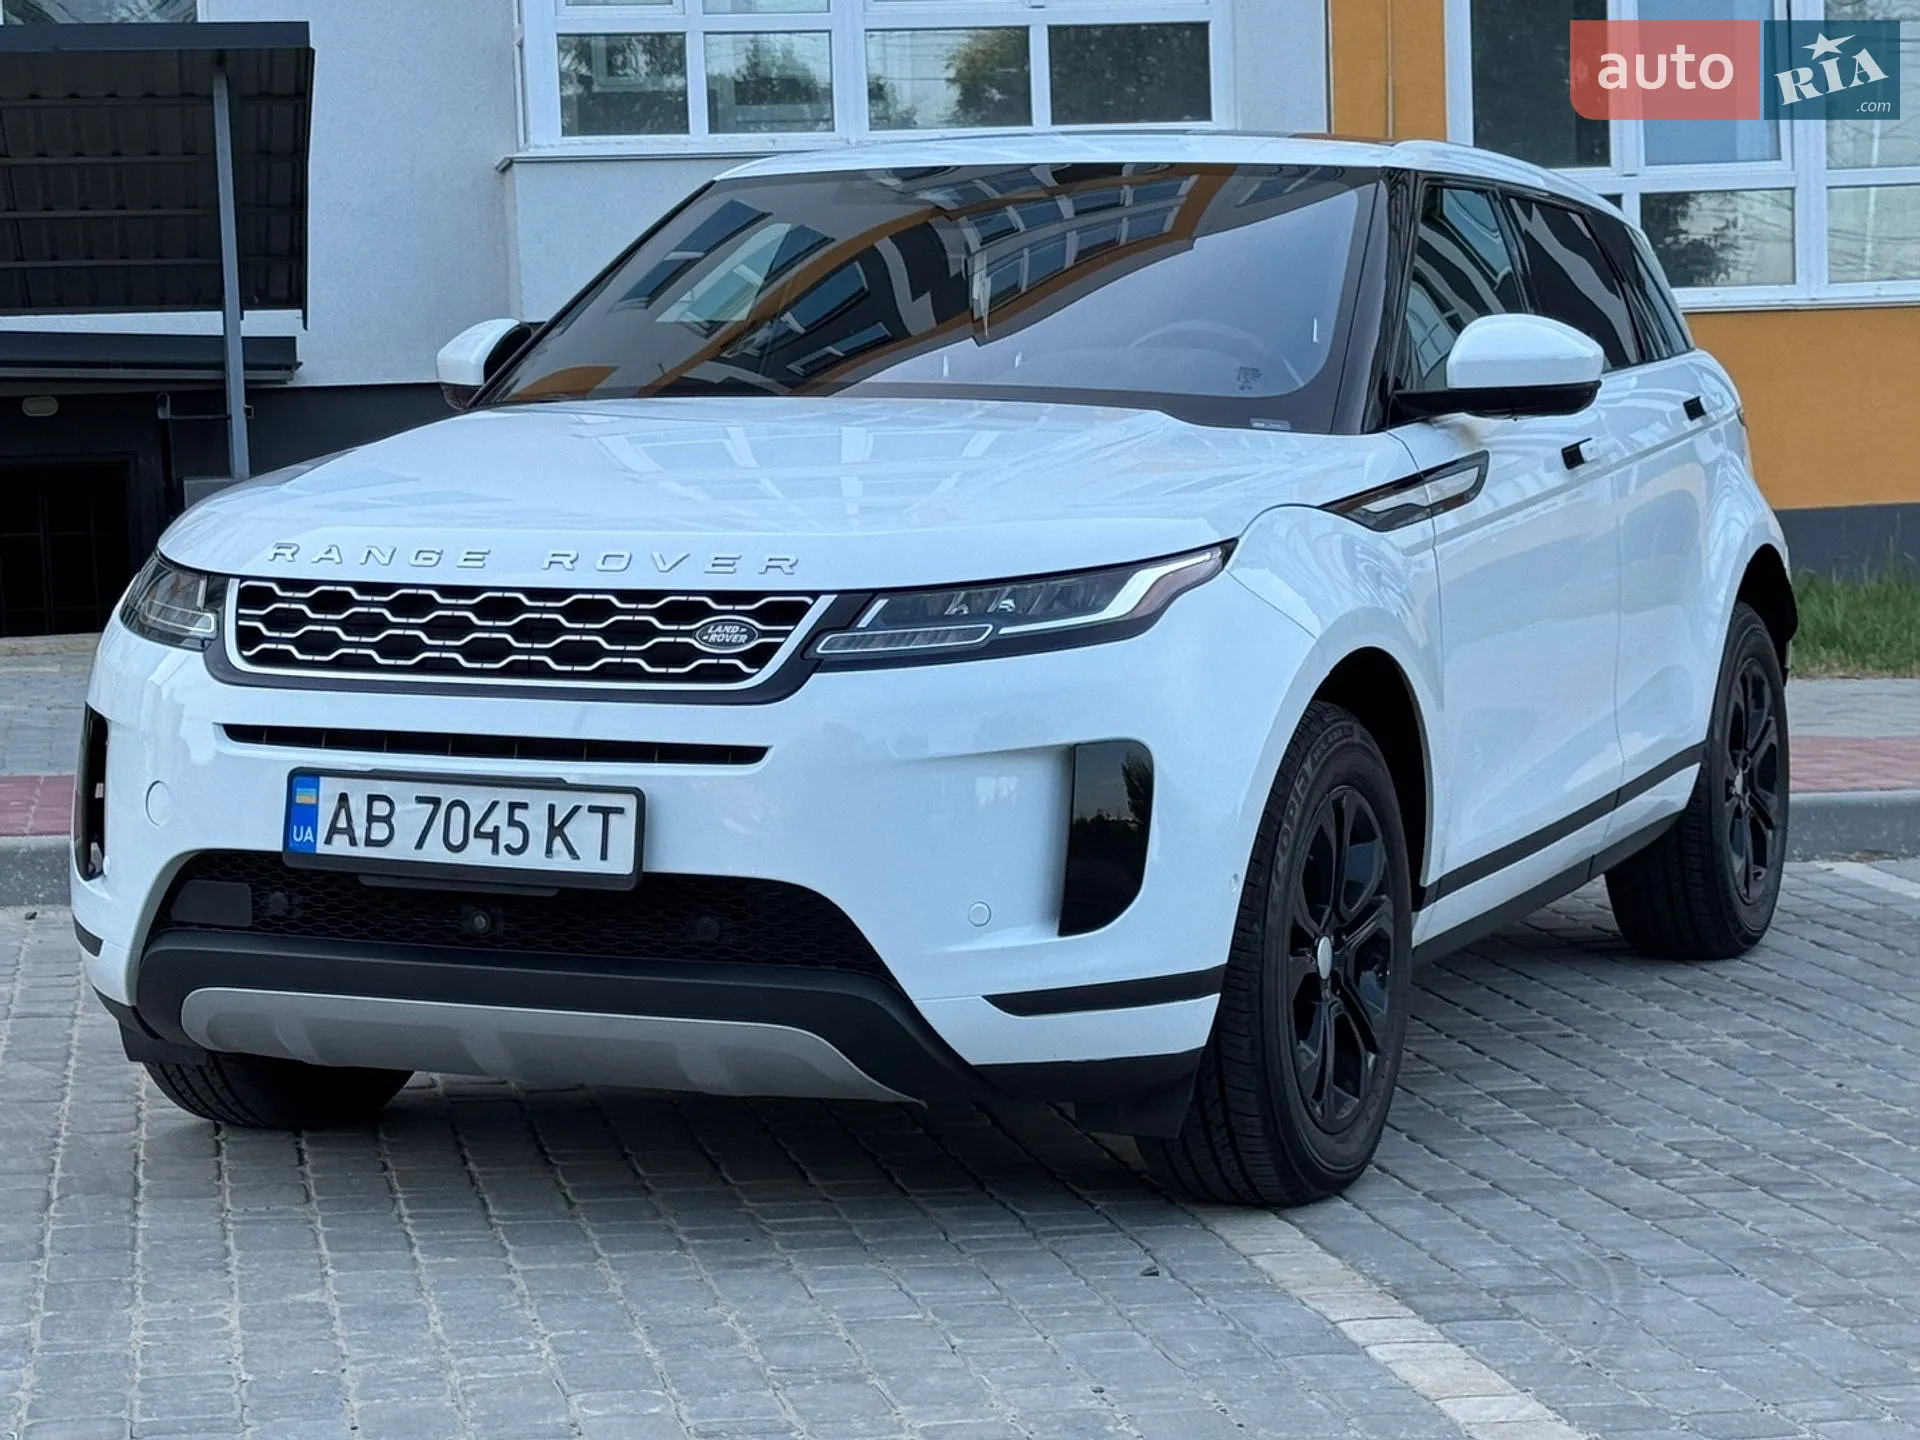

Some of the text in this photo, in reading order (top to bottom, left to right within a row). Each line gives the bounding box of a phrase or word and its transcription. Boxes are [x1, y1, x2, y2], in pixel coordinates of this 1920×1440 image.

[267, 542, 799, 576] RANGE ROVER
[707, 624, 740, 634] LAND
[708, 633, 748, 643] ROVER
[293, 824, 315, 844] UA
[323, 791, 625, 861] AB 7045 KT
